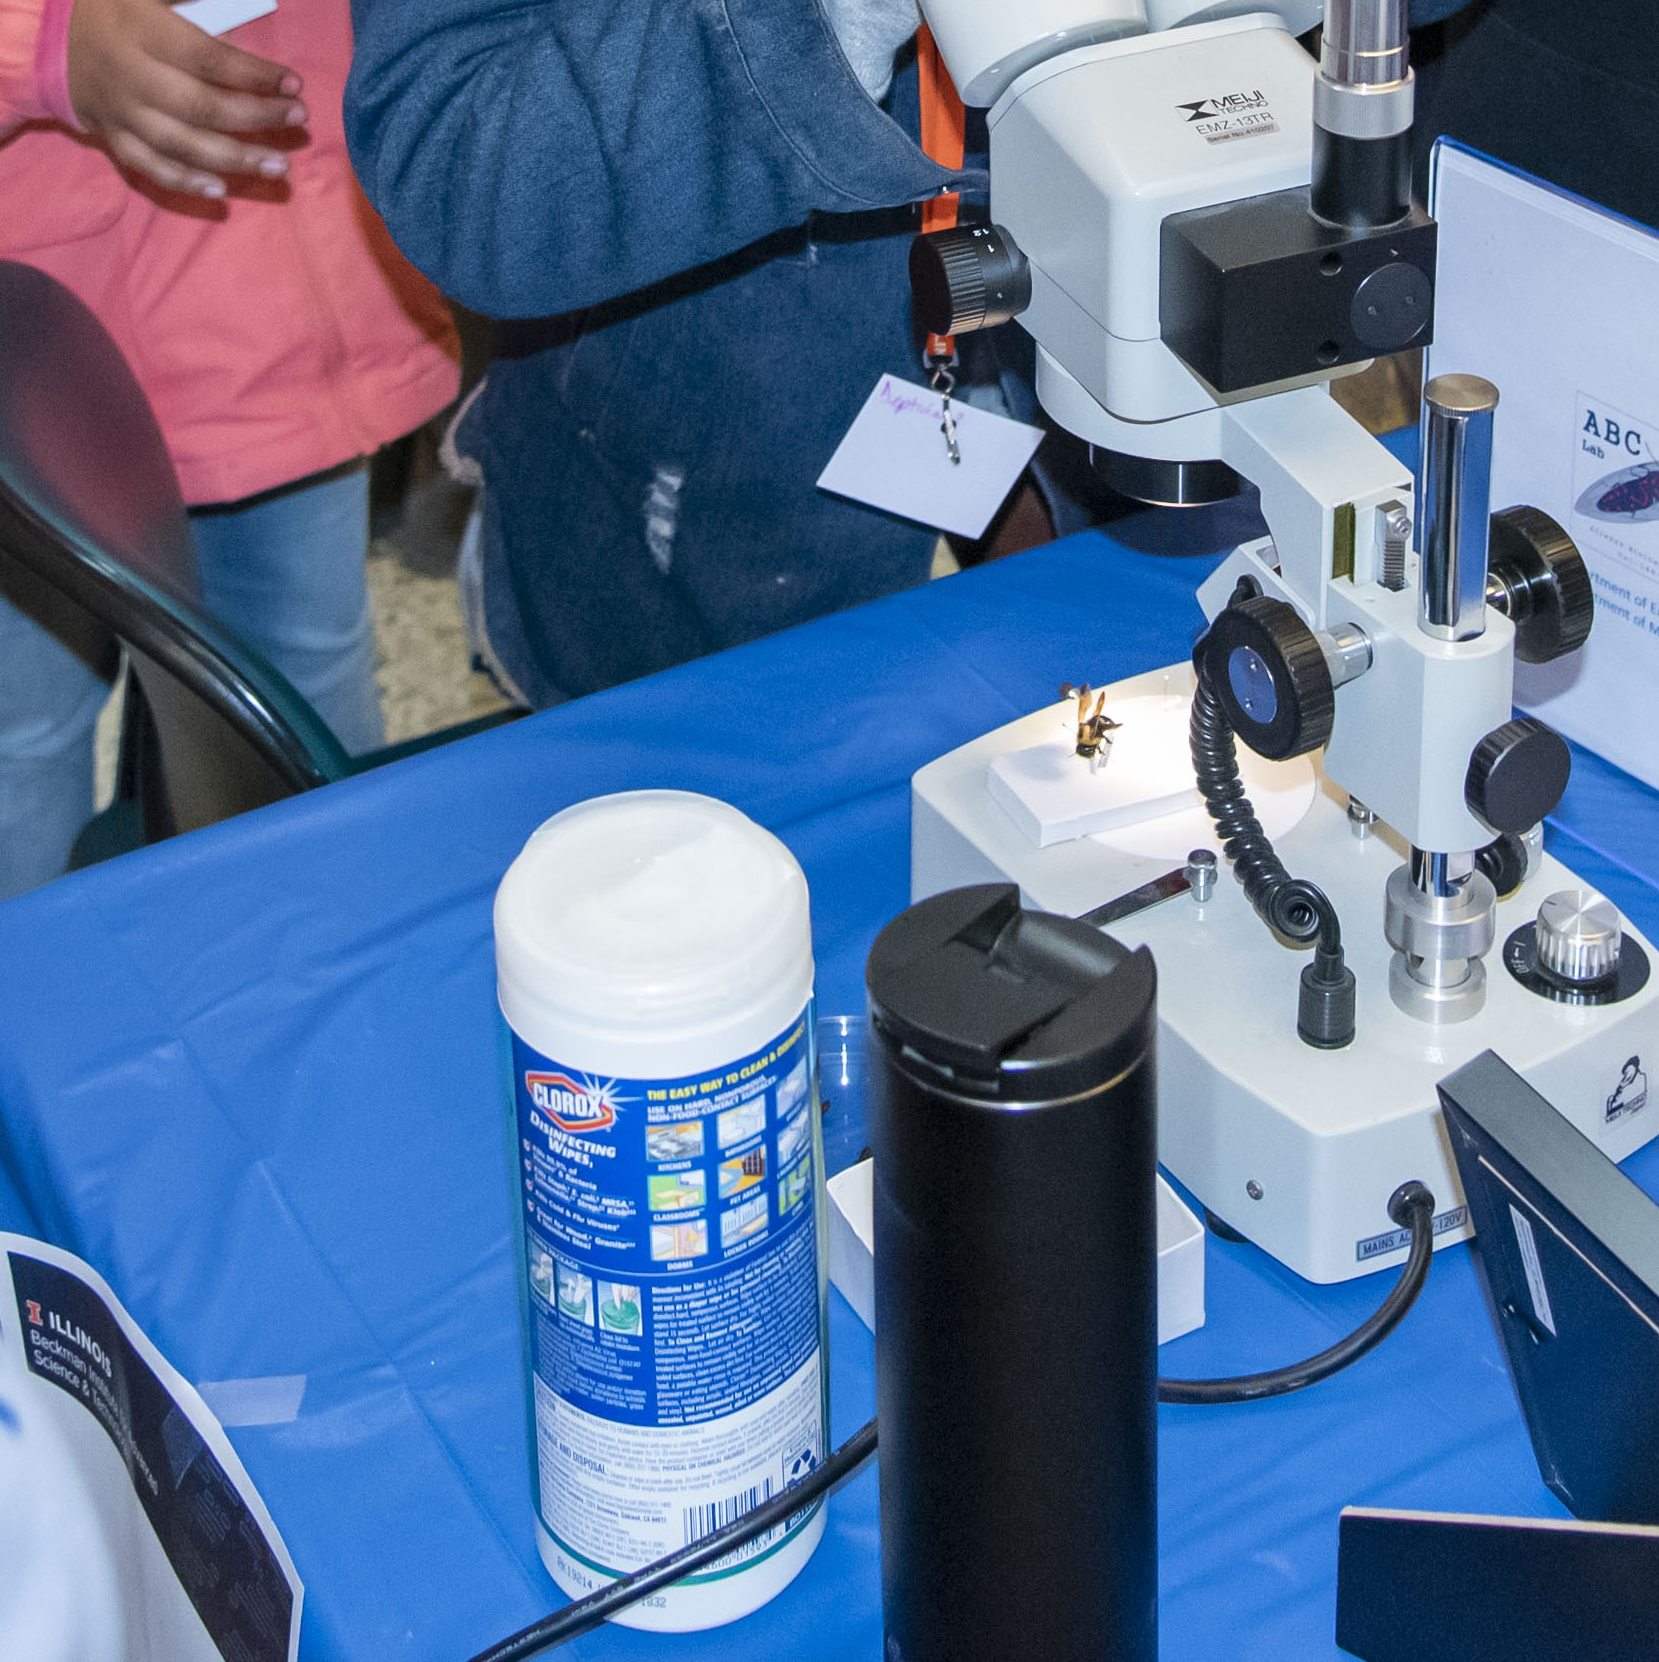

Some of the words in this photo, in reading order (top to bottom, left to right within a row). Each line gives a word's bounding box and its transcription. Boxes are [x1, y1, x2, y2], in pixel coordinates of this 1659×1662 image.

[1210, 90, 1266, 109] MEIJI
[1220, 100, 1269, 115] TECHNO
[1196, 112, 1274, 135] EMZ-13TR
[1582, 439, 1605, 459] Lab
[1583, 410, 1641, 456] ABC
[1590, 572, 1632, 602] rtment
[1634, 596, 1647, 609] of
[1594, 593, 1630, 621] tment
[1633, 615, 1646, 628] of
[648, 1090, 667, 1101] THE
[669, 1085, 697, 1100] EASY
[700, 1078, 723, 1093] WAY
[726, 1072, 739, 1085] TO
[740, 1056, 769, 1079] CLEAN
[533, 1082, 604, 1118] CLOROX
[648, 1106, 665, 1114] USE
[668, 1104, 682, 1113] ON
[1363, 1237, 1394, 1256] MAINS
[1399, 1231, 1412, 1243] AC
[1432, 1210, 1461, 1228] -120V
[30, 1329, 87, 1374] Beckman
[48, 1311, 112, 1378] ILLINOIS
[33, 1350, 80, 1388] Science
[82, 1380, 90, 1396] &
